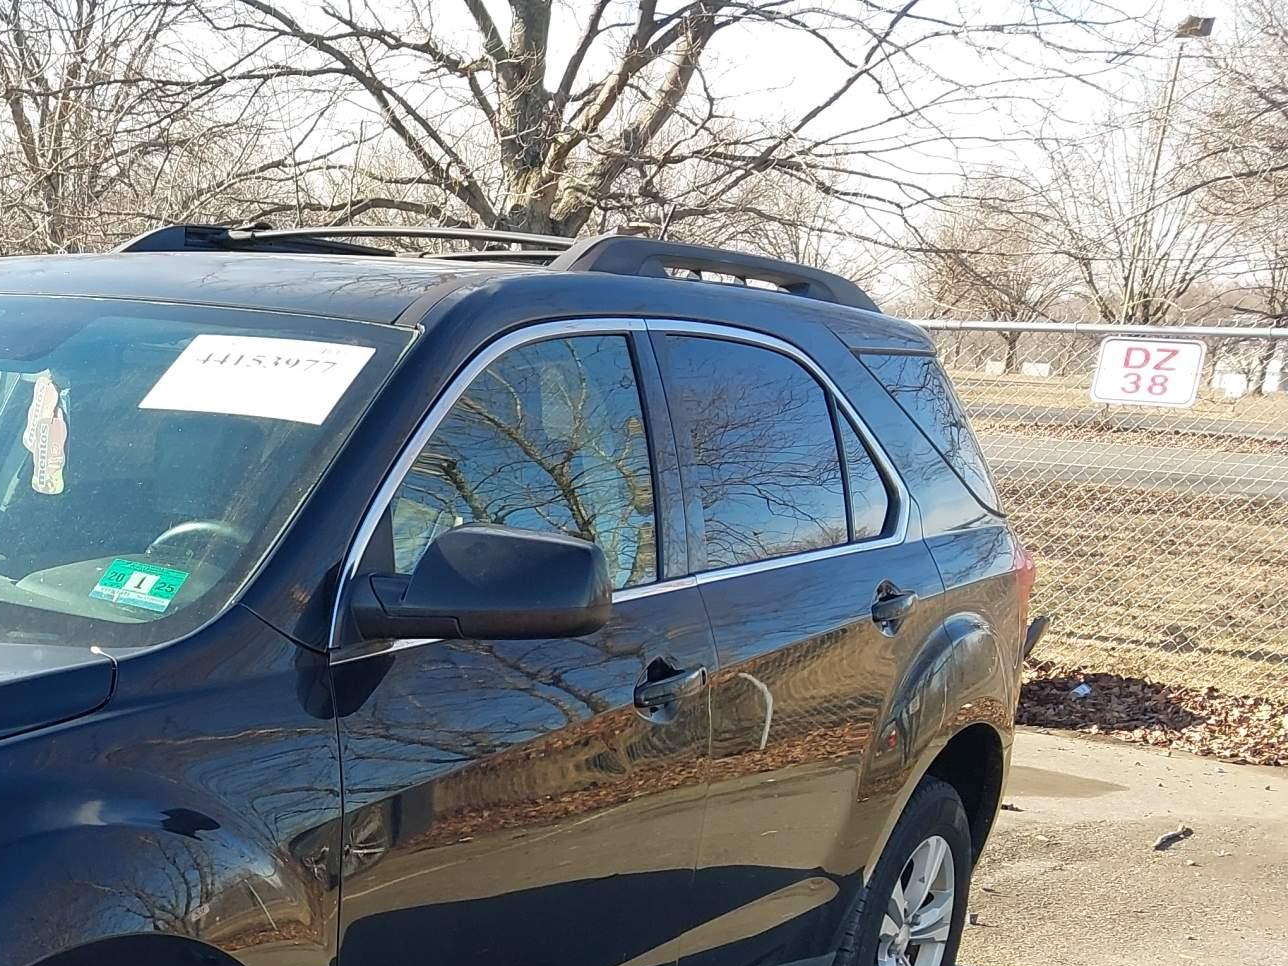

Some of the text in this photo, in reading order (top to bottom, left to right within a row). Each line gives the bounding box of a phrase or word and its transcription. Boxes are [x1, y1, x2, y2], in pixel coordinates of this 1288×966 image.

[1123, 347, 1179, 371] DZ
[1120, 372, 1169, 396] 38
[38, 424, 48, 486] mentos
[133, 576, 147, 590] 1
[155, 581, 175, 593] 25
